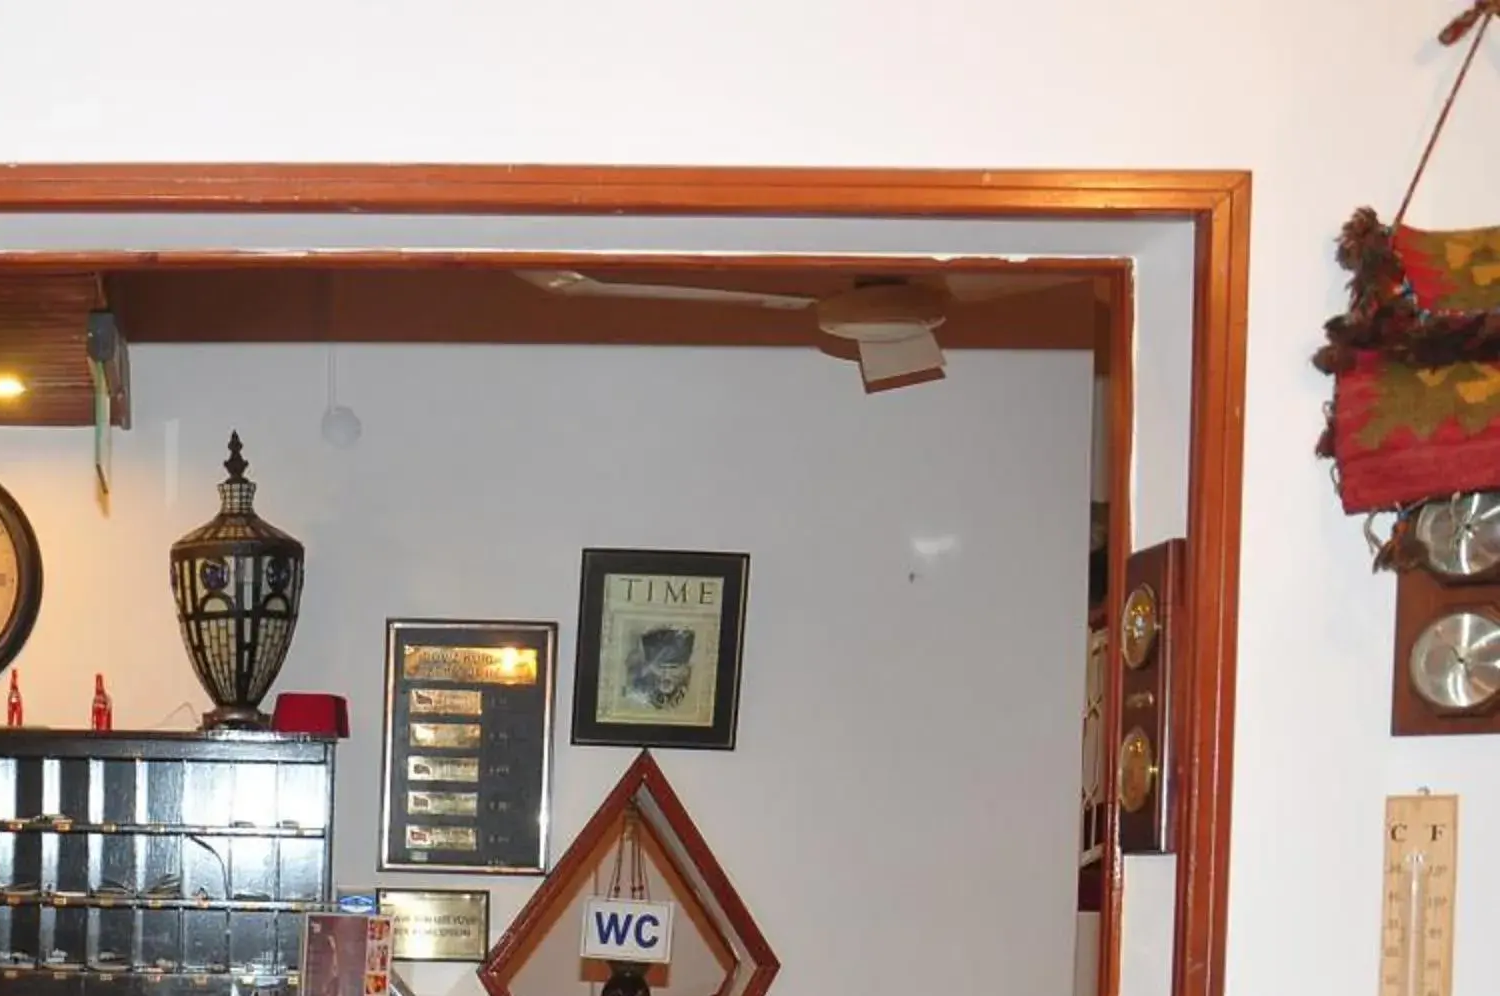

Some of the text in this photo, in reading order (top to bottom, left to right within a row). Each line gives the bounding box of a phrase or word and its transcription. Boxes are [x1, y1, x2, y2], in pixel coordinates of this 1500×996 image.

[618, 577, 717, 605] TIME
[1390, 822, 1446, 843] C F
[595, 911, 659, 949] WC
